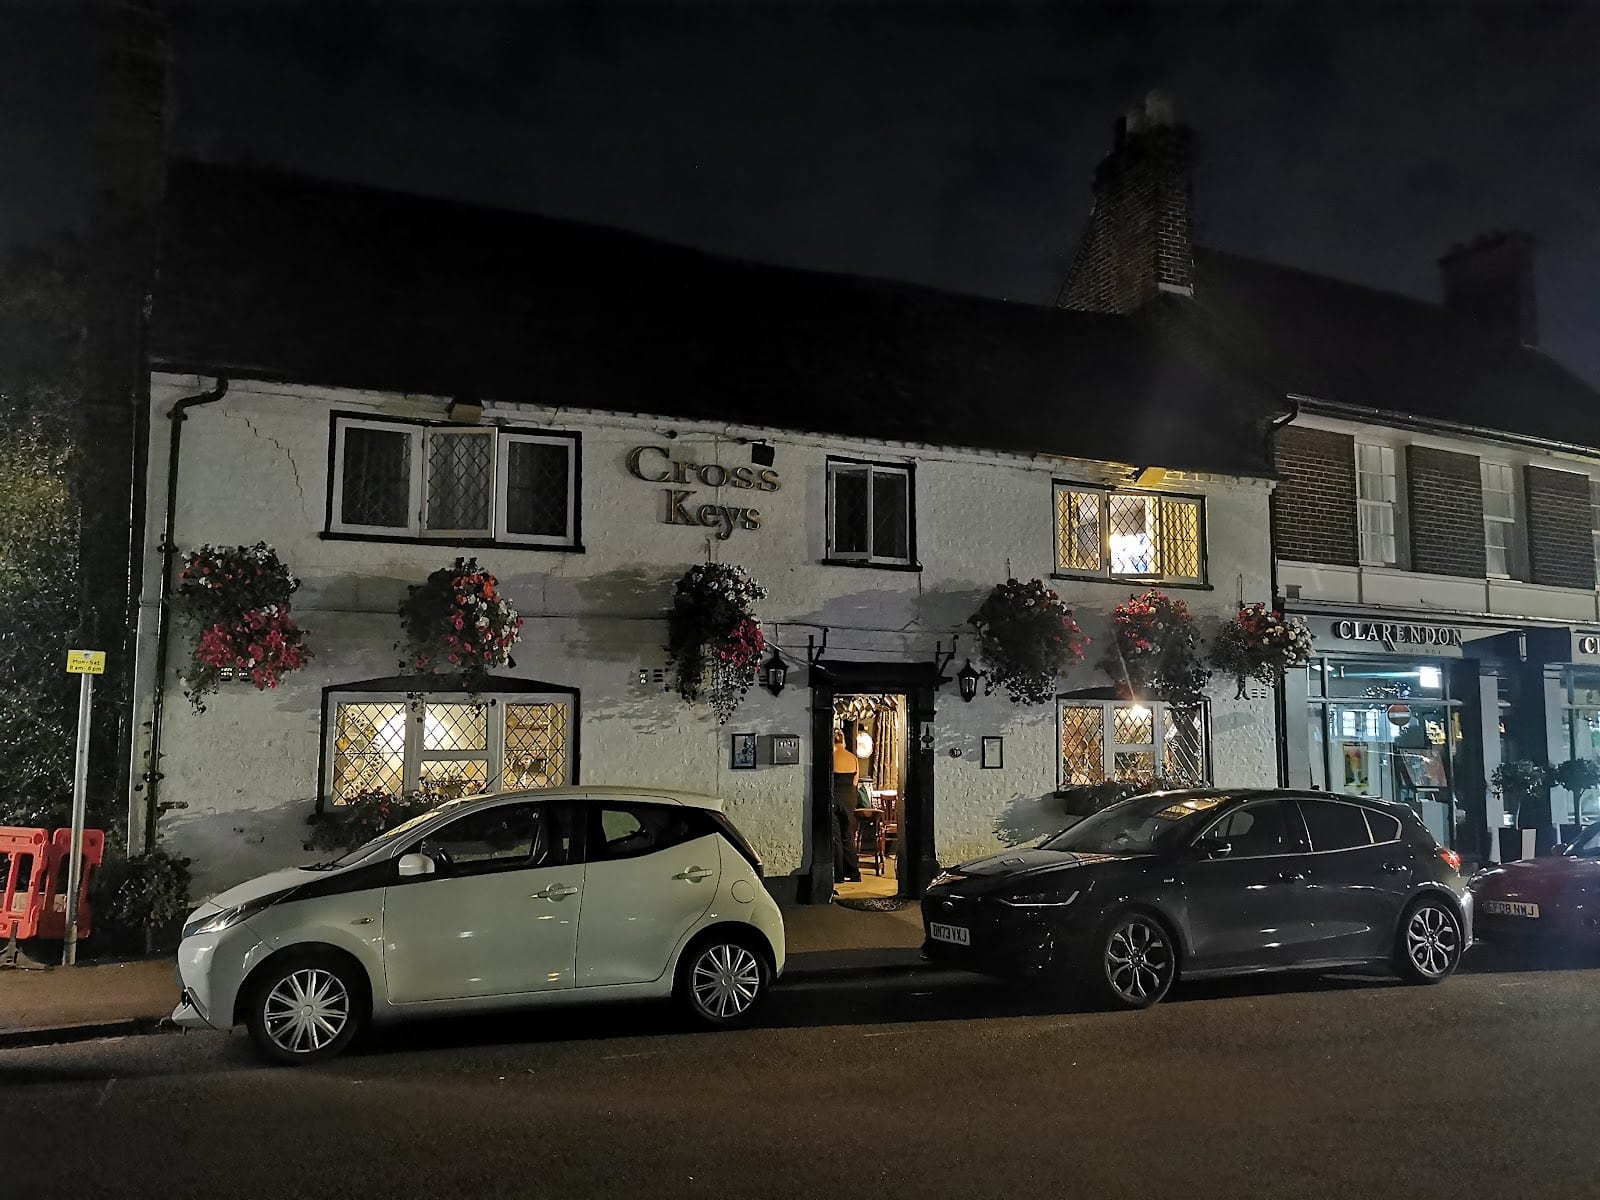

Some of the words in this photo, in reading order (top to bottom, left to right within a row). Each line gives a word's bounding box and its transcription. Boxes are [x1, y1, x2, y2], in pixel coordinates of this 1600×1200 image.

[628, 446, 781, 491] Cross
[661, 489, 761, 540] Keys
[1337, 620, 1463, 652] CLARENDON
